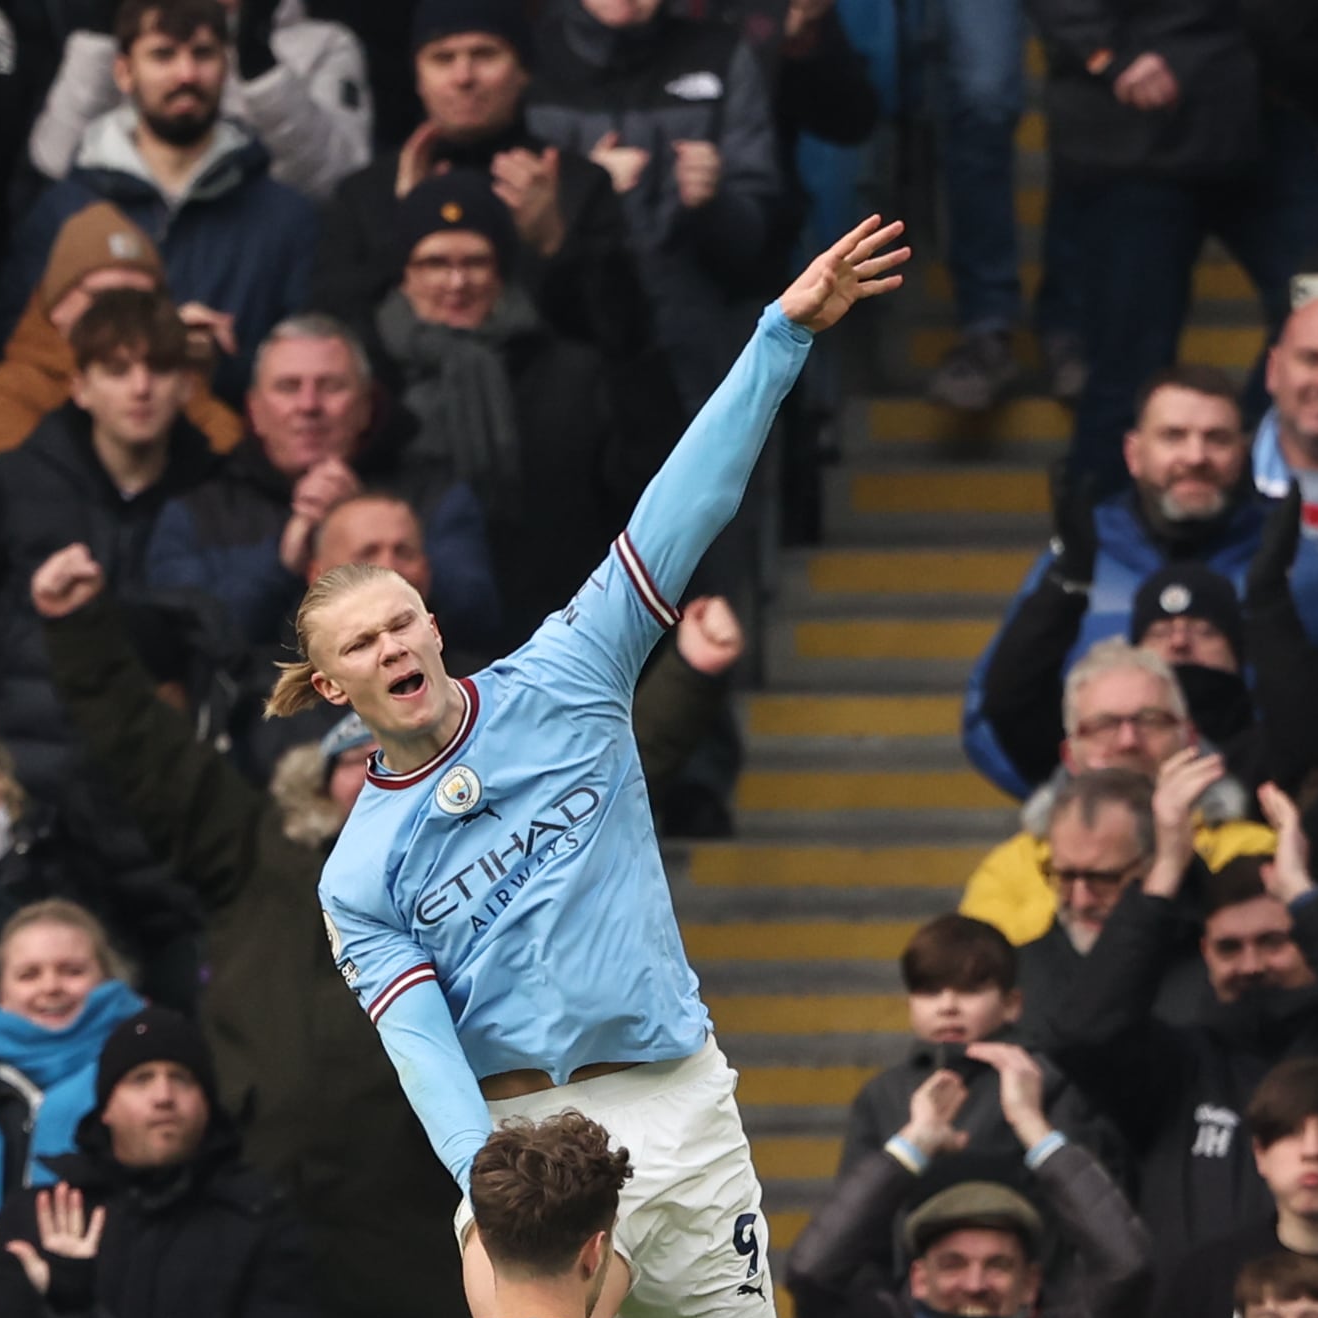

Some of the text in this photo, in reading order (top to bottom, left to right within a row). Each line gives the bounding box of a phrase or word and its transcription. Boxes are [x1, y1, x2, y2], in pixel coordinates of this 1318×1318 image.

[415, 786, 600, 926] ETIHAD
[469, 831, 580, 933] AIRWAYS
[732, 1213, 759, 1279] 9
